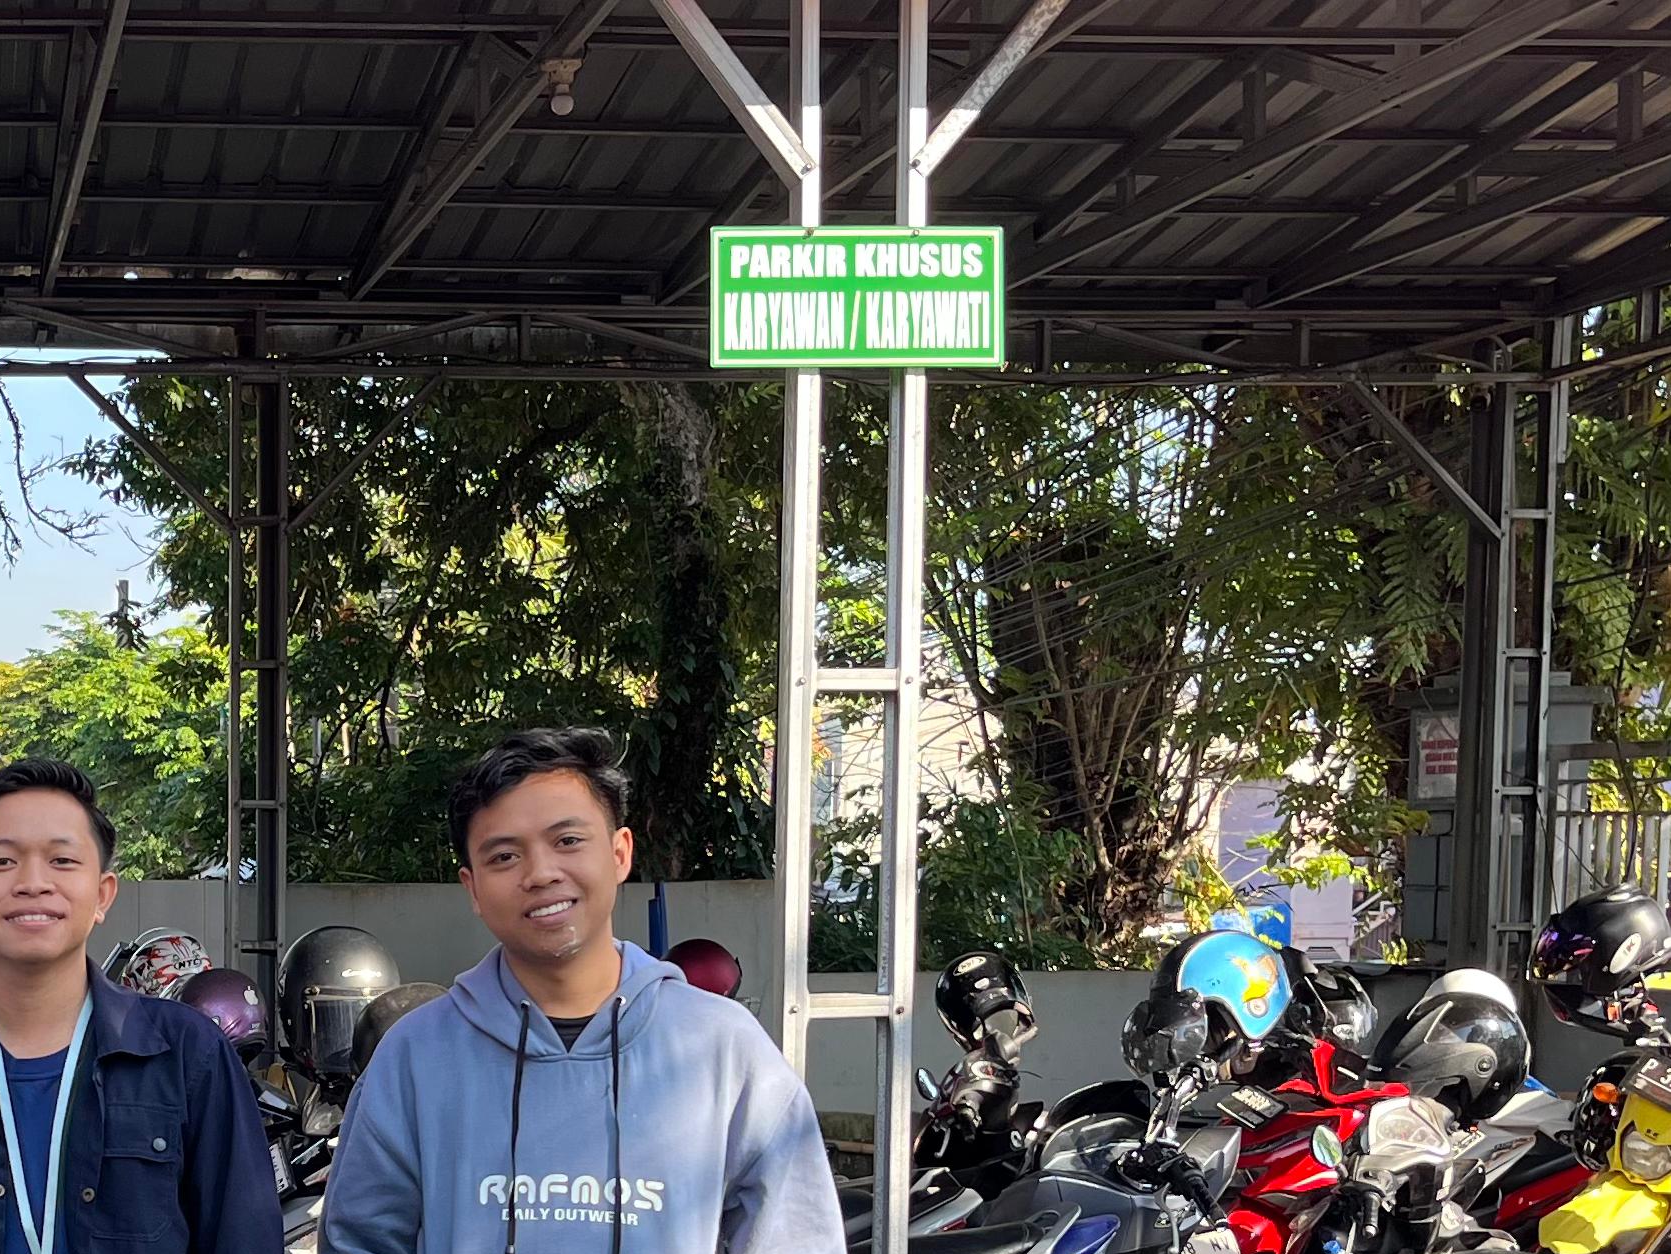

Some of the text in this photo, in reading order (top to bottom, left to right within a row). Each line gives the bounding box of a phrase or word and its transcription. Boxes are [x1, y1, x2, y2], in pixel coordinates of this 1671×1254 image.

[730, 243, 983, 279] PARKIR KHUSUS
[724, 291, 990, 350] KARYAWAN / KARYAWATI
[1641, 1058, 1659, 1074] P
